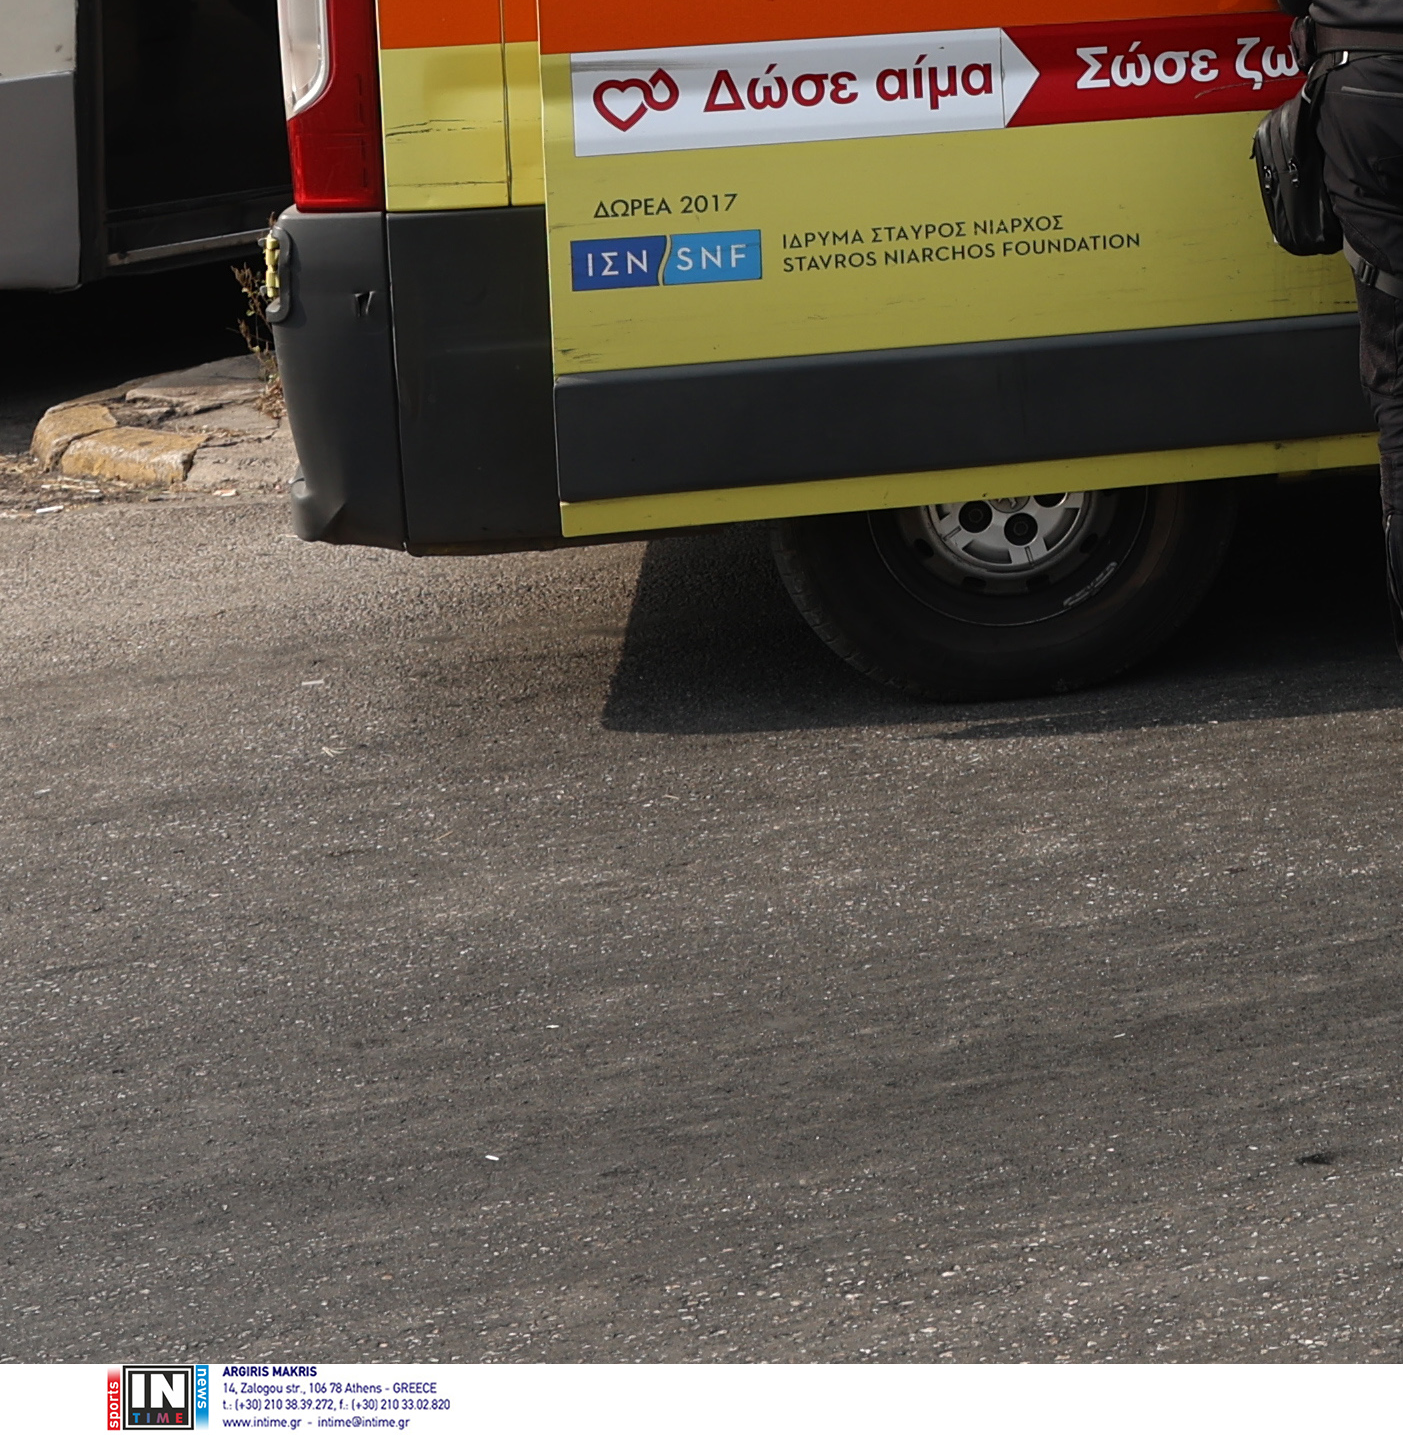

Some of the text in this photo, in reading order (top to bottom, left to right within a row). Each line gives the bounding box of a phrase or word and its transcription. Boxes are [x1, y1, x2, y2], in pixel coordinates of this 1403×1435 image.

[1076, 41, 1219, 89] Σώσε
[703, 54, 993, 113] Δώσε αίμα
[593, 193, 738, 218] ΔΩΡΕΑ 2017
[782, 215, 1064, 249] ΙΔΡΥΜΑ ΣΤΑΥΡΟΣ ΝΙΑΡΧΟΣ
[587, 249, 648, 277] ΙΣΝ
[676, 243, 747, 271] SNF
[783, 233, 1141, 273] STAVROS NIARCHOS FOUNDATION
